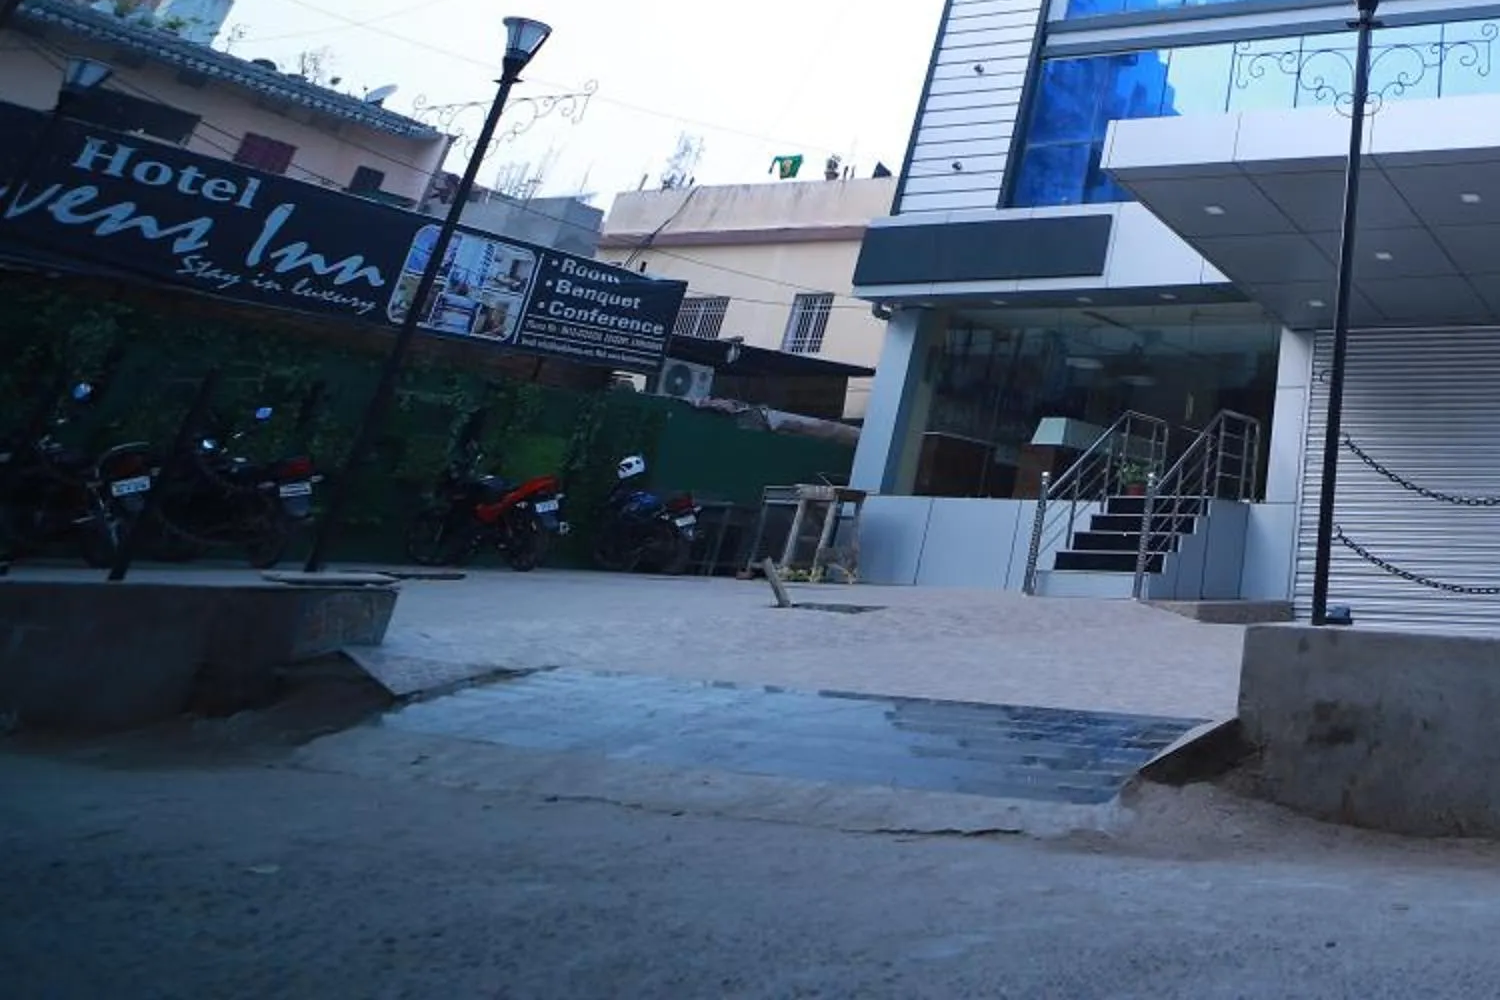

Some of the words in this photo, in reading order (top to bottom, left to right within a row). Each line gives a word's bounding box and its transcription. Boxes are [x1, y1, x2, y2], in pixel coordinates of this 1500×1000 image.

[71, 136, 261, 209] Hotel
[245, 203, 385, 287] Inn
[175, 254, 241, 289] Stay
[252, 272, 283, 291] in
[555, 278, 641, 310] Banquet
[548, 300, 665, 335] Conference
